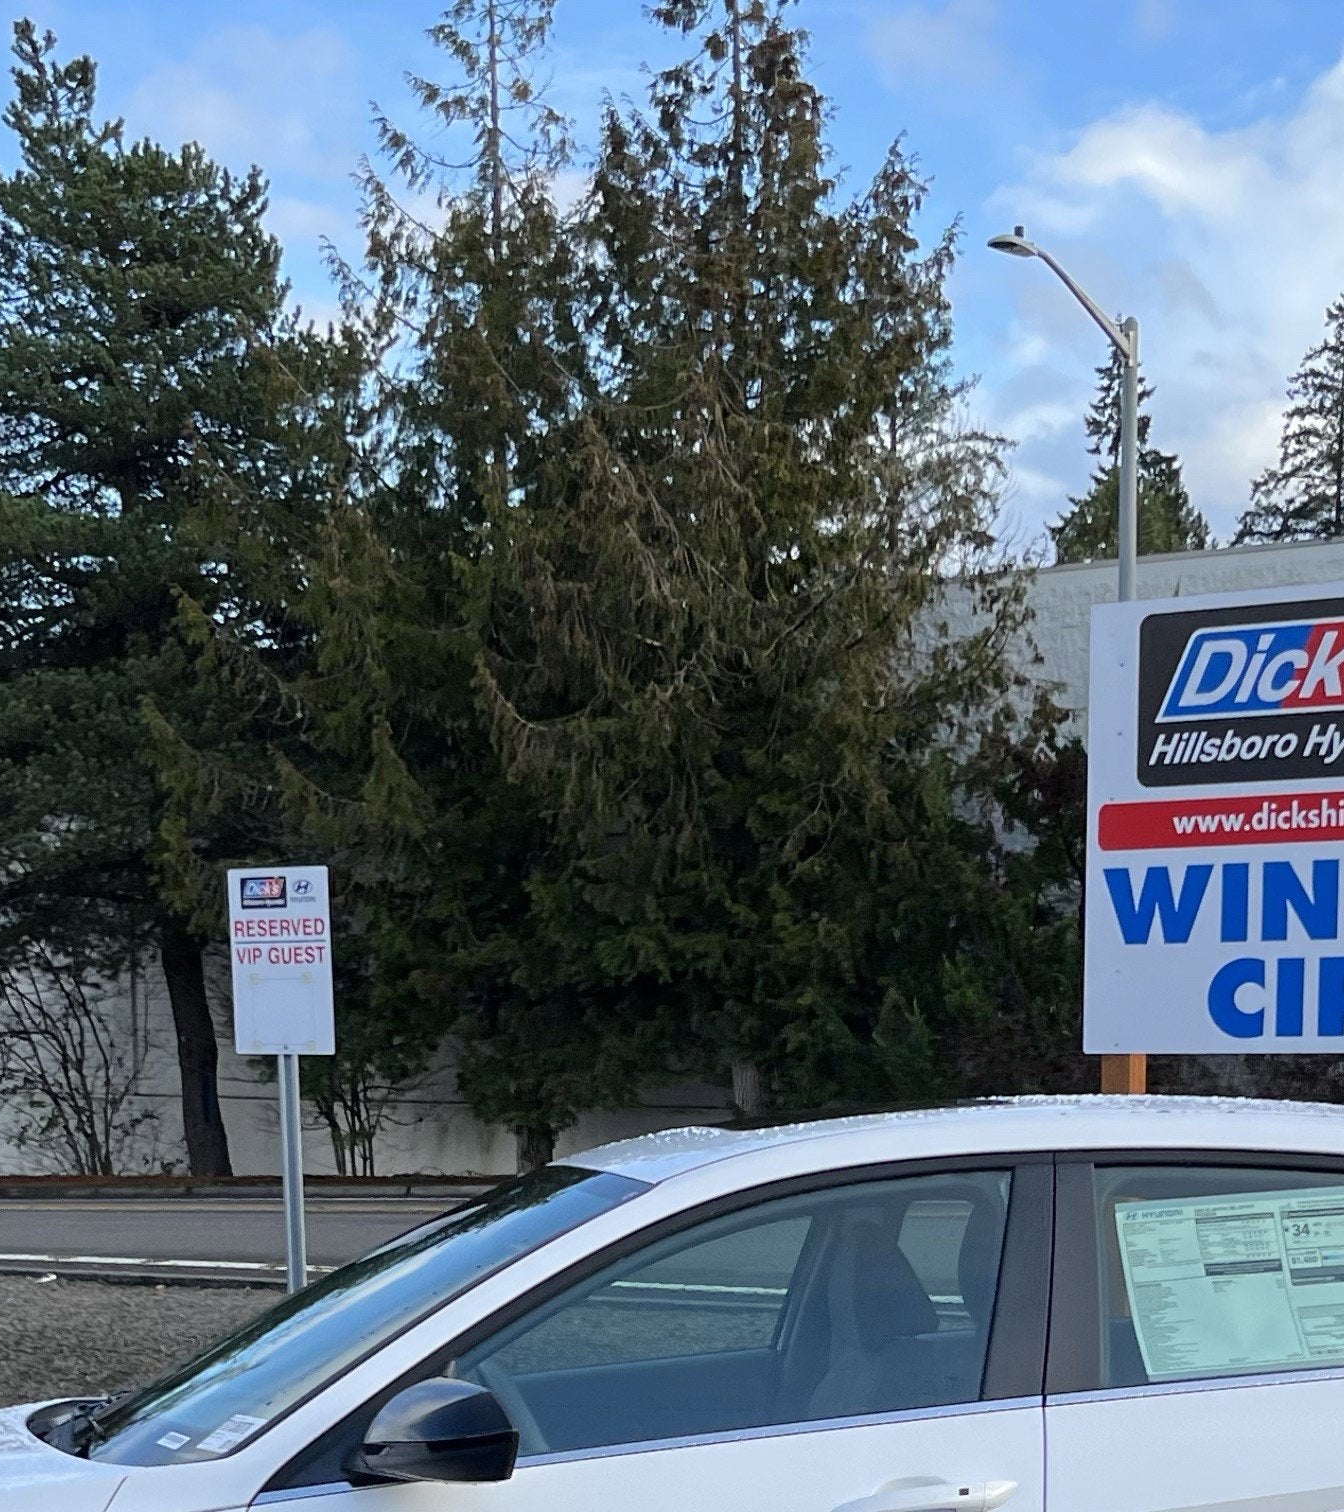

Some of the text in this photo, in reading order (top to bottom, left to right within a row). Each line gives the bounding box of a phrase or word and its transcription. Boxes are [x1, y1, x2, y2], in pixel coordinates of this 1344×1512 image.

[1148, 729, 1299, 767] Hillsboro
[233, 918, 326, 938] RESERVED
[236, 946, 326, 965] VIP GUEST
[1292, 1223, 1311, 1237] 34
